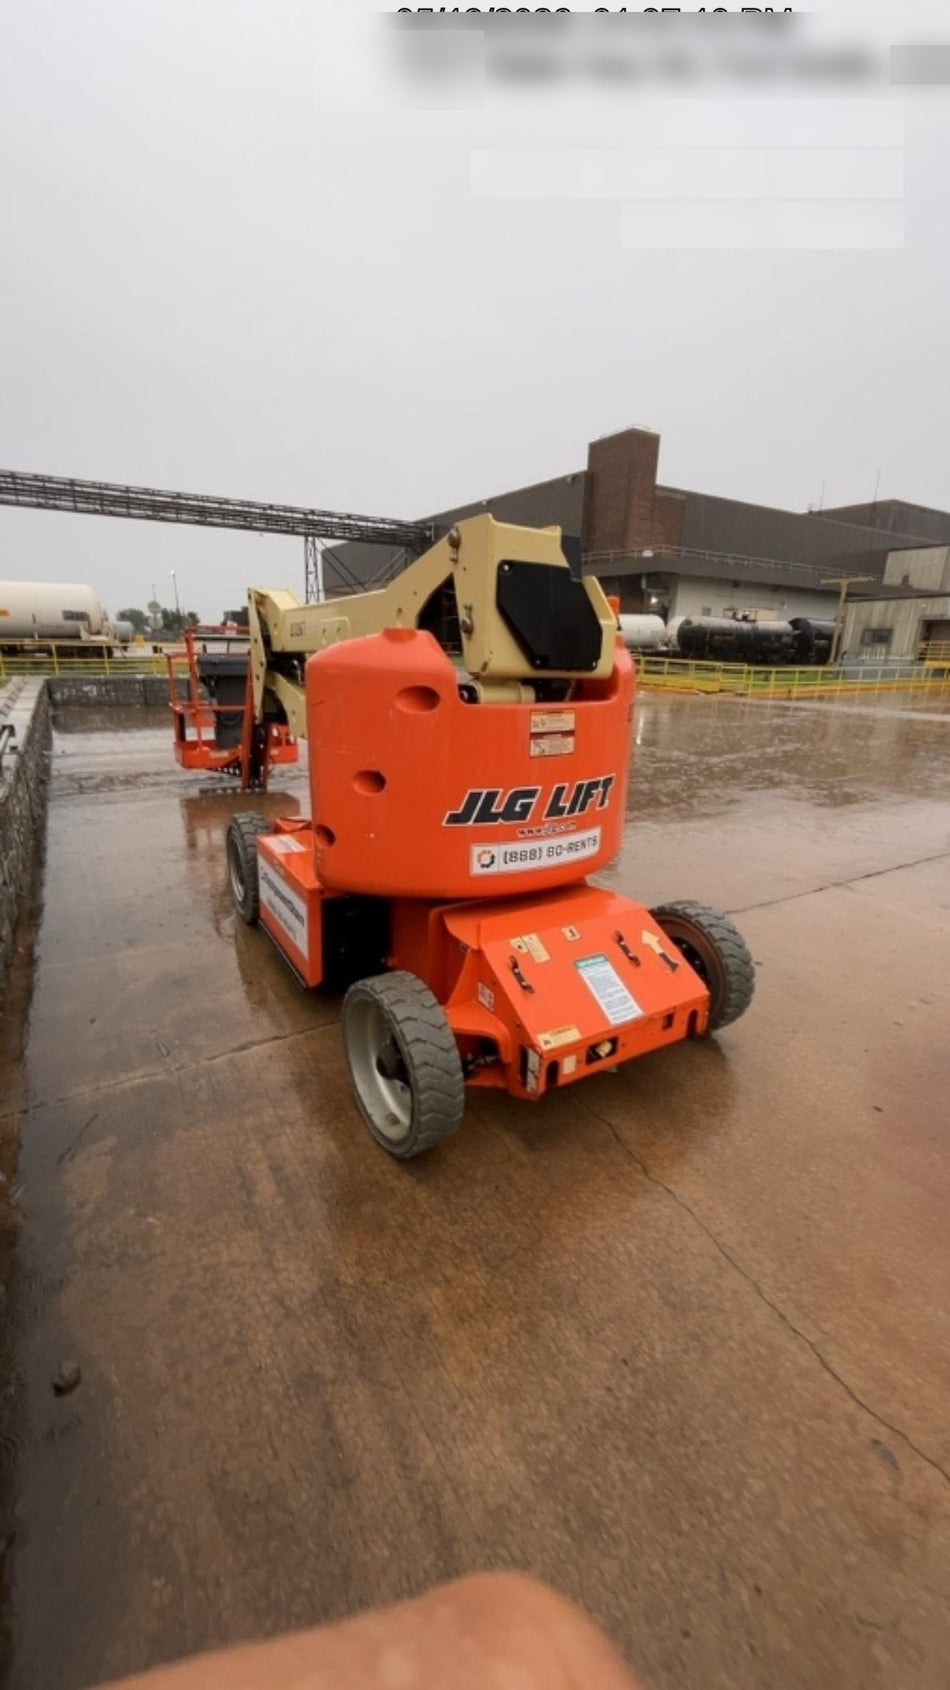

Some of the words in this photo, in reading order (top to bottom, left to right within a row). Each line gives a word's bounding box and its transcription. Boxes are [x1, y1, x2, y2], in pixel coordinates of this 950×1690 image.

[443, 787, 541, 826] JLG
[543, 774, 615, 820] LIFT
[503, 848, 543, 864] (888)
